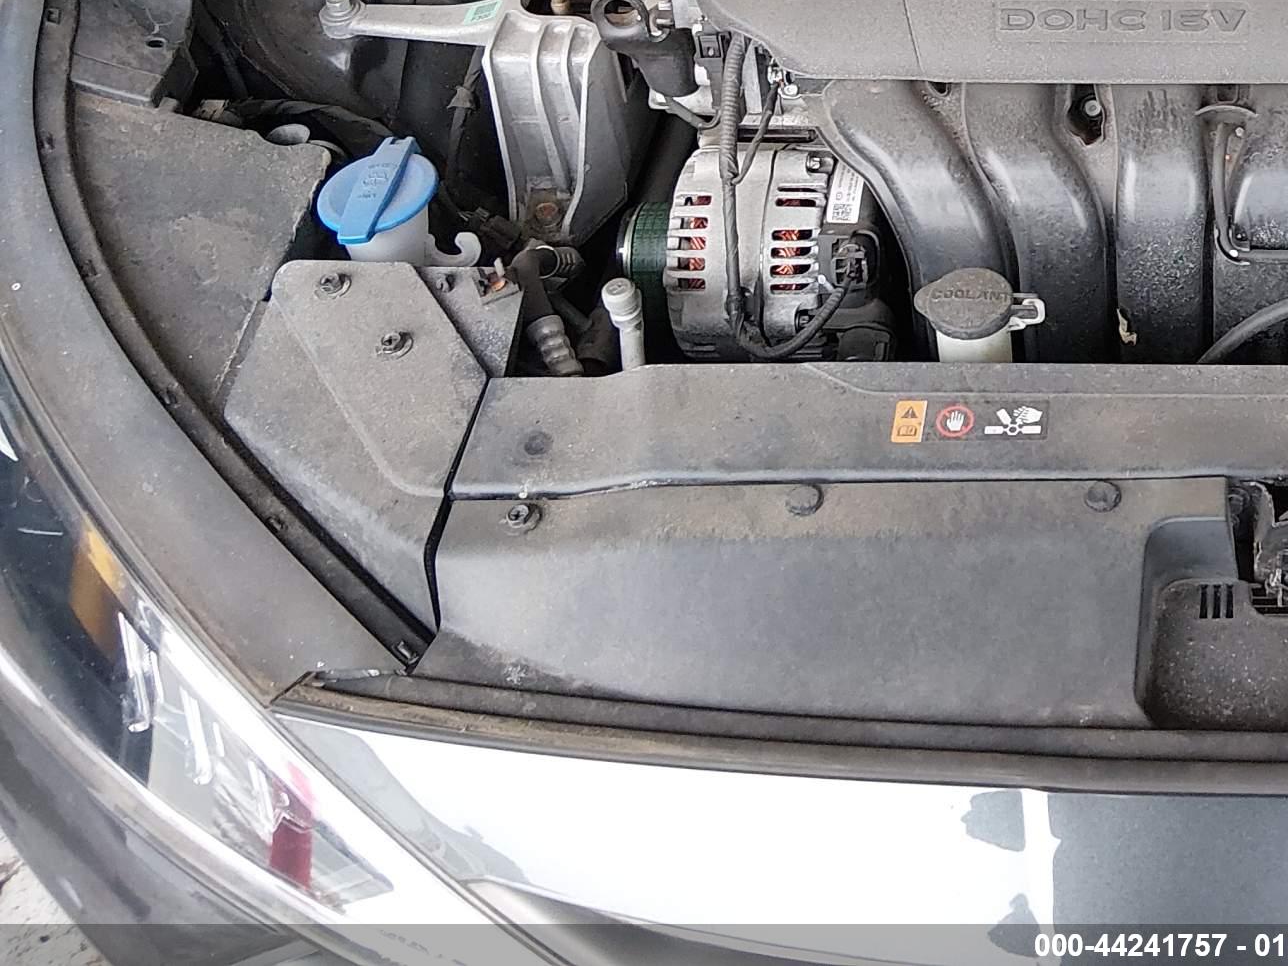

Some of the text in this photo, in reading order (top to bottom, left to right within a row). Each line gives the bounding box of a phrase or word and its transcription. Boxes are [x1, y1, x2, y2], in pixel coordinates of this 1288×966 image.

[999, 8, 1247, 32] DOHC 16V
[930, 288, 1009, 303] COOLANT
